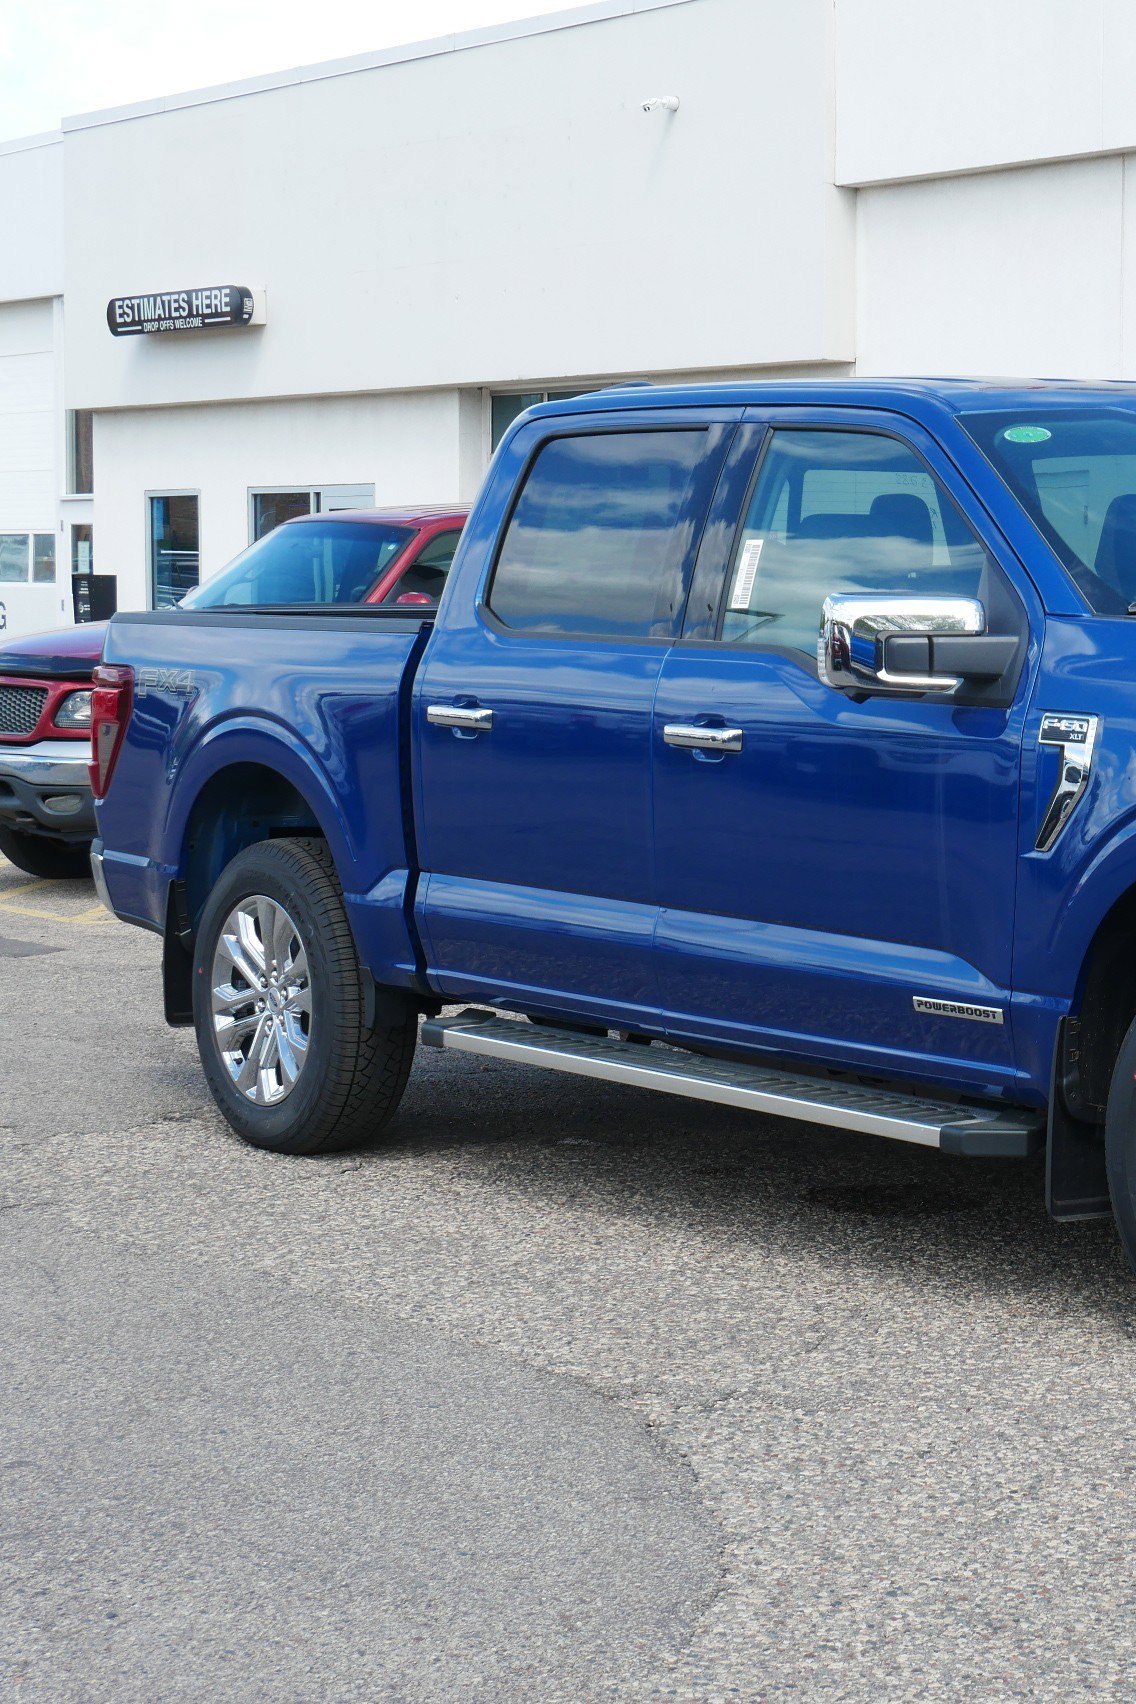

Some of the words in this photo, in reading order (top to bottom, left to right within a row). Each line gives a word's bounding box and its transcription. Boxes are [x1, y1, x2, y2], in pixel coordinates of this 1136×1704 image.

[115, 293, 189, 323] ESTIMATES
[192, 288, 231, 315] HERE
[143, 321, 159, 332] DROP
[159, 320, 175, 331] OFFS
[174, 316, 203, 329] WELCOME
[138, 667, 196, 699] FX4
[1043, 718, 1089, 733] F-150
[916, 999, 998, 1020] POWERBOOST
